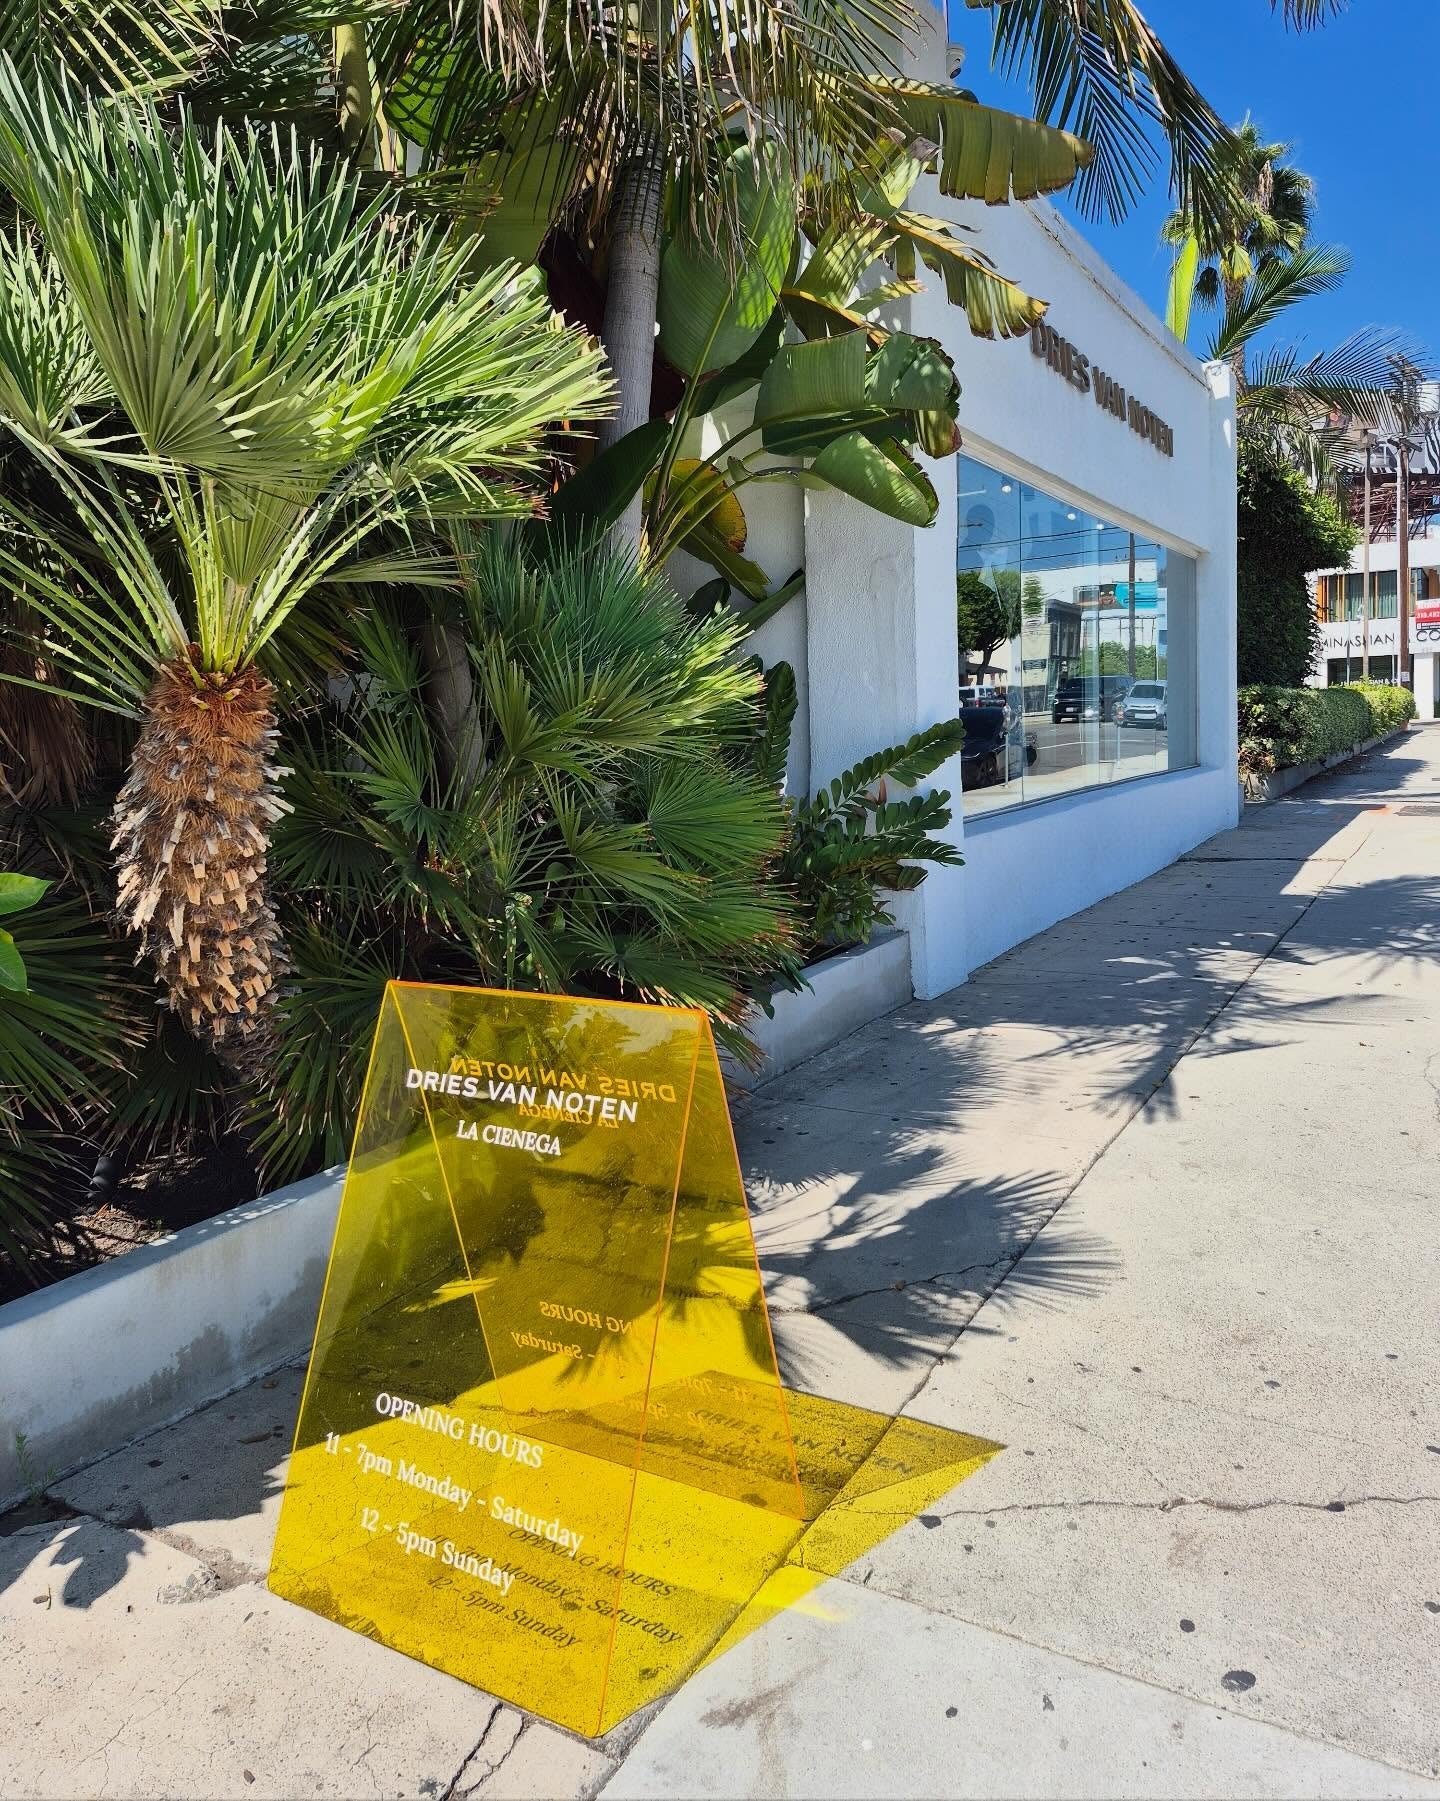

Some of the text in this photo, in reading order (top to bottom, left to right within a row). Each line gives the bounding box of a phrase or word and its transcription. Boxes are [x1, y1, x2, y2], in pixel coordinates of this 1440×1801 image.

[1030, 319, 1174, 457] DRIES VAN NOTEN
[406, 1068, 639, 1123] DRIES VAN NOTEN
[456, 1119, 562, 1156] LA CIENEGA
[375, 1392, 544, 1469] OPENING HOURS
[325, 1432, 340, 1456] 11
[357, 1443, 393, 1477] 7pm
[396, 1459, 472, 1512] Monday
[490, 1495, 585, 1557] Saturday
[361, 1506, 379, 1532] 12
[396, 1522, 437, 1559] 5pm
[441, 1541, 516, 1597] Sunday
[509, 1528, 678, 1598] OPENING HOURS
[462, 1590, 506, 1615] 5pm
[505, 1608, 582, 1649] Sunday
[586, 1598, 684, 1645] Saturday
